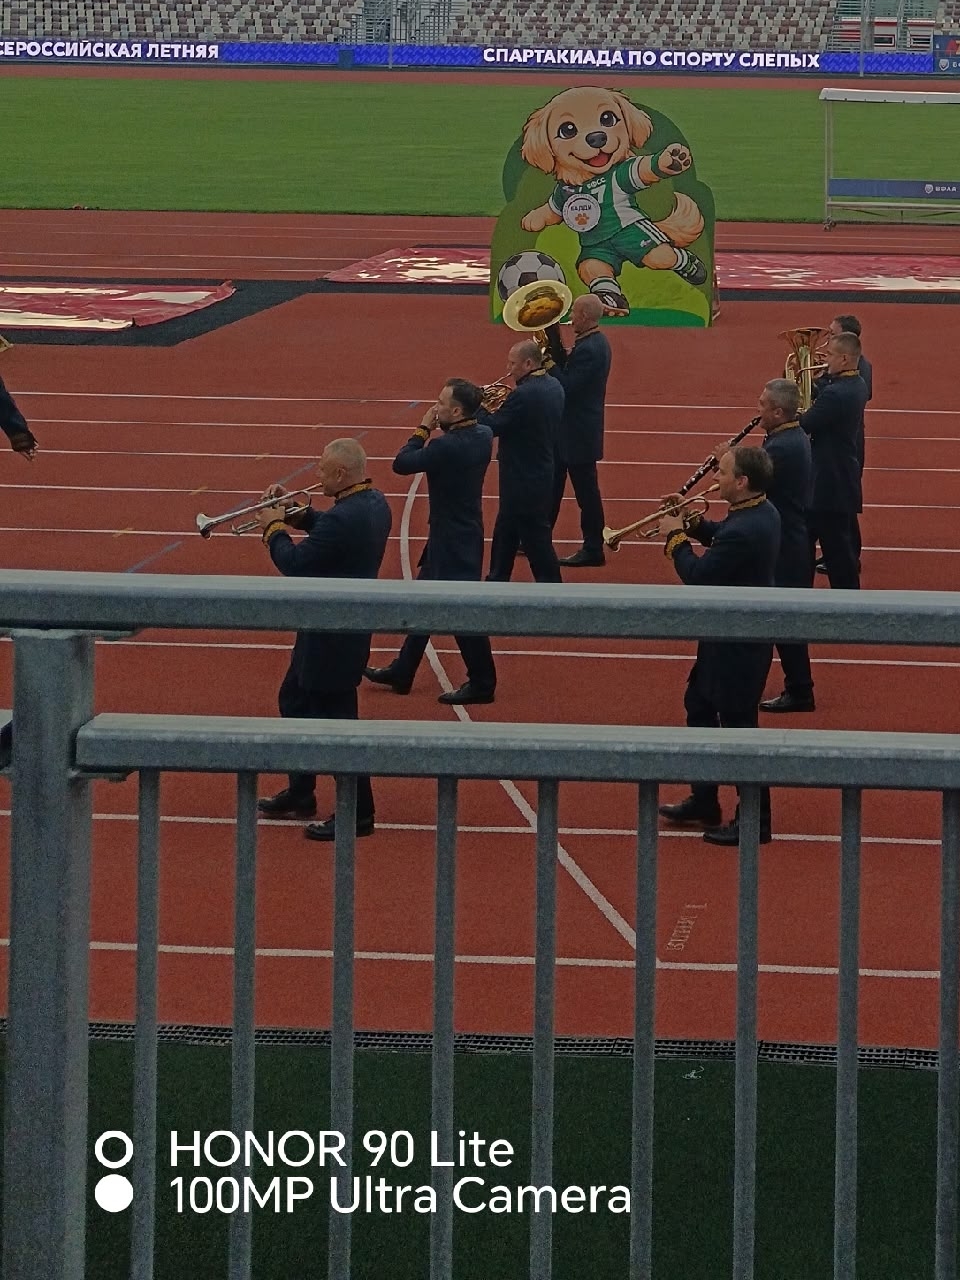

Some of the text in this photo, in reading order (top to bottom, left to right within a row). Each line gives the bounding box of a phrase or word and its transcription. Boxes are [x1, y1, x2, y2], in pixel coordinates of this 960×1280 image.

[0, 40, 219, 59] ЕРОССИЙСКАЯ ЛЕТНЯЯ
[483, 48, 820, 68] СПАРТАКИАДА ПО СПОРТУ СЛЕПЫХ
